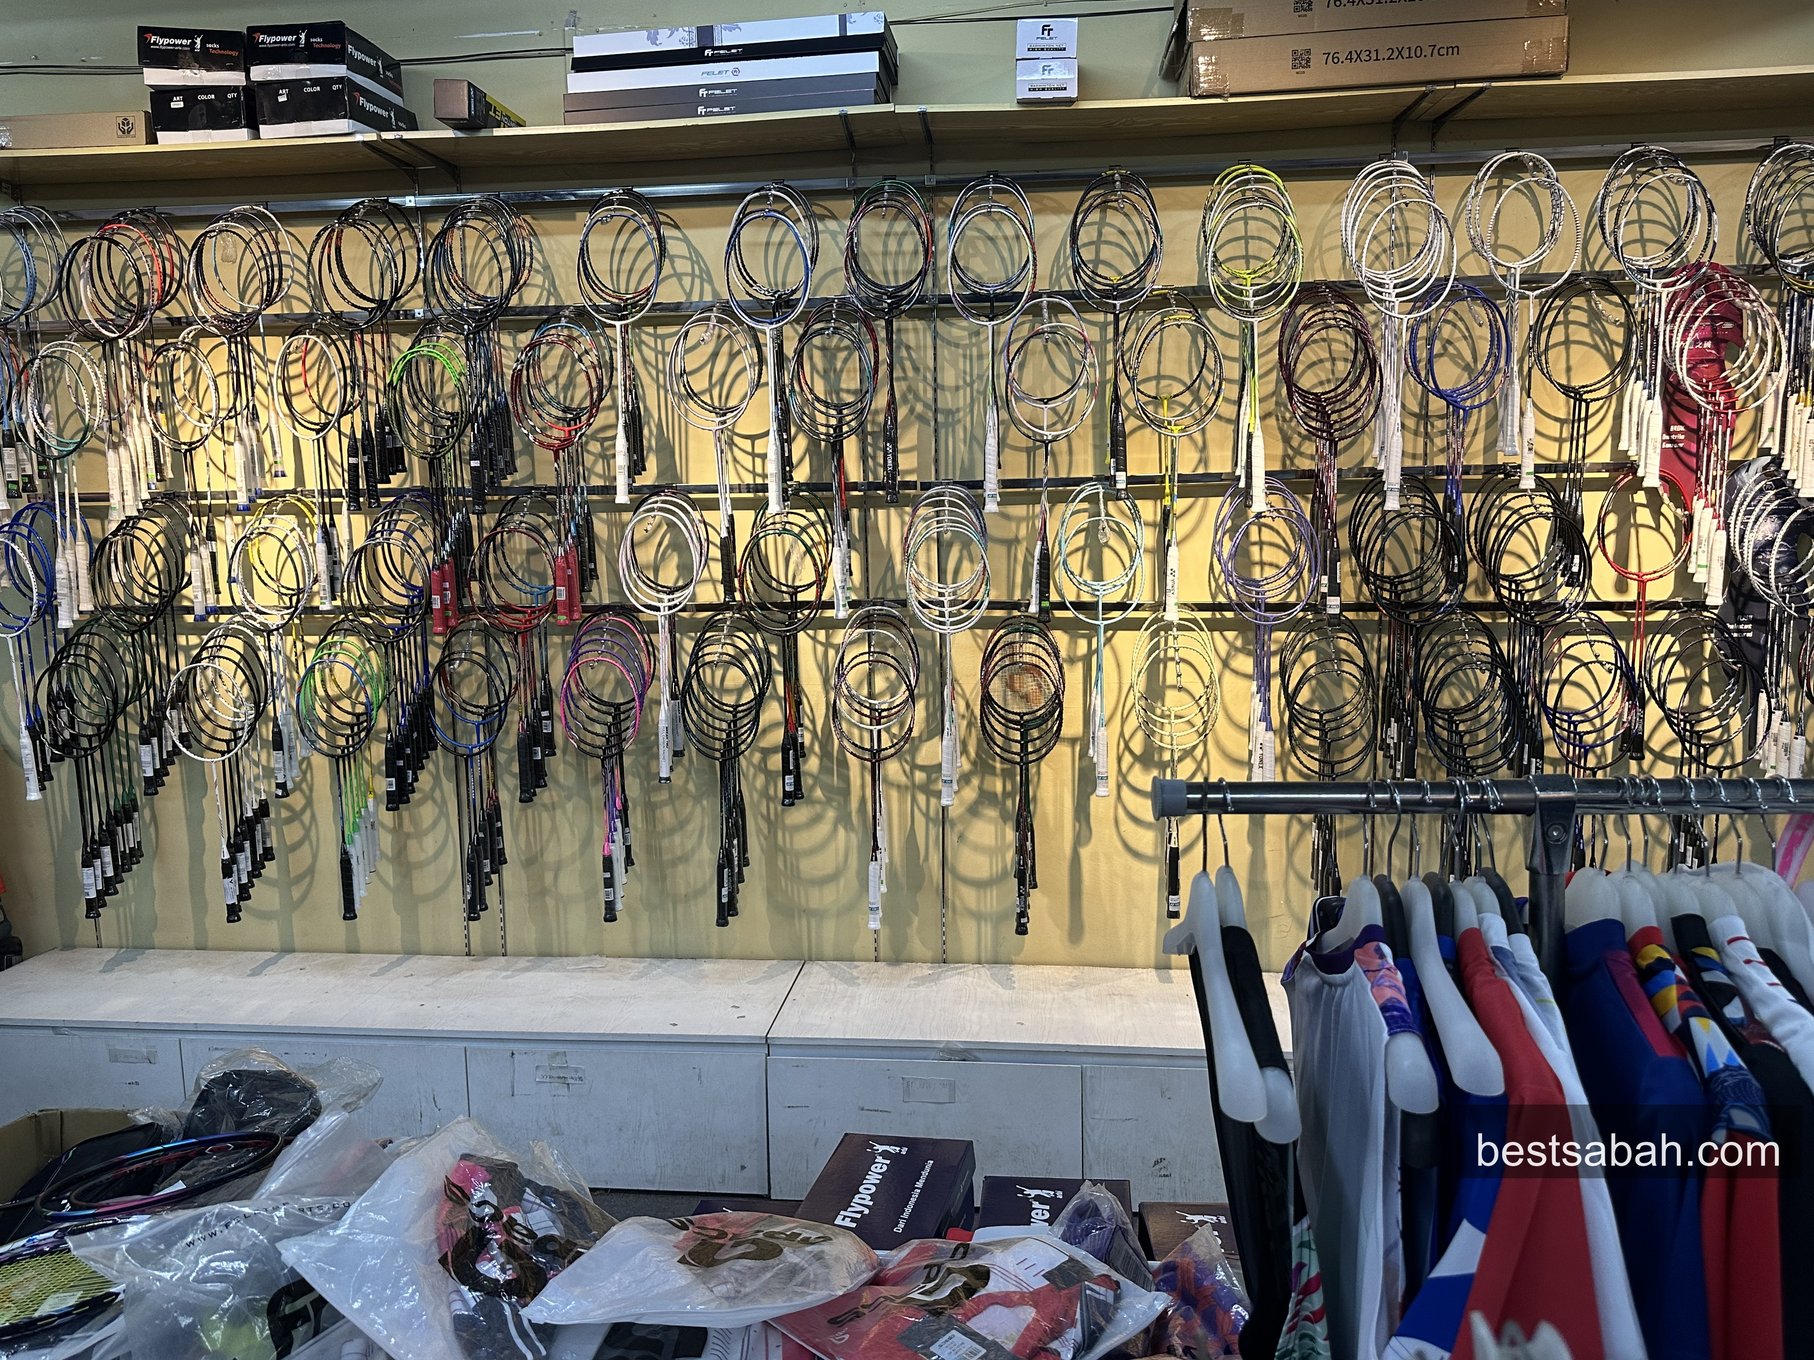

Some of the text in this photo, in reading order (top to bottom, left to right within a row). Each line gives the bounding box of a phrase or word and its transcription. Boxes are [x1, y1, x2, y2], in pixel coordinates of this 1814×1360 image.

[150, 35, 192, 46] Flypower
[258, 34, 297, 44] Flypower
[208, 48, 240, 57] Technology
[347, 44, 377, 67] Flypower
[1322, 44, 1460, 65] 76.4X31.2X10.7cm
[700, 69, 730, 77] FELET
[359, 96, 389, 119] Flypower
[833, 1156, 891, 1228] Flypower
[893, 1159, 934, 1233] Dari Indonesia Mendunia
